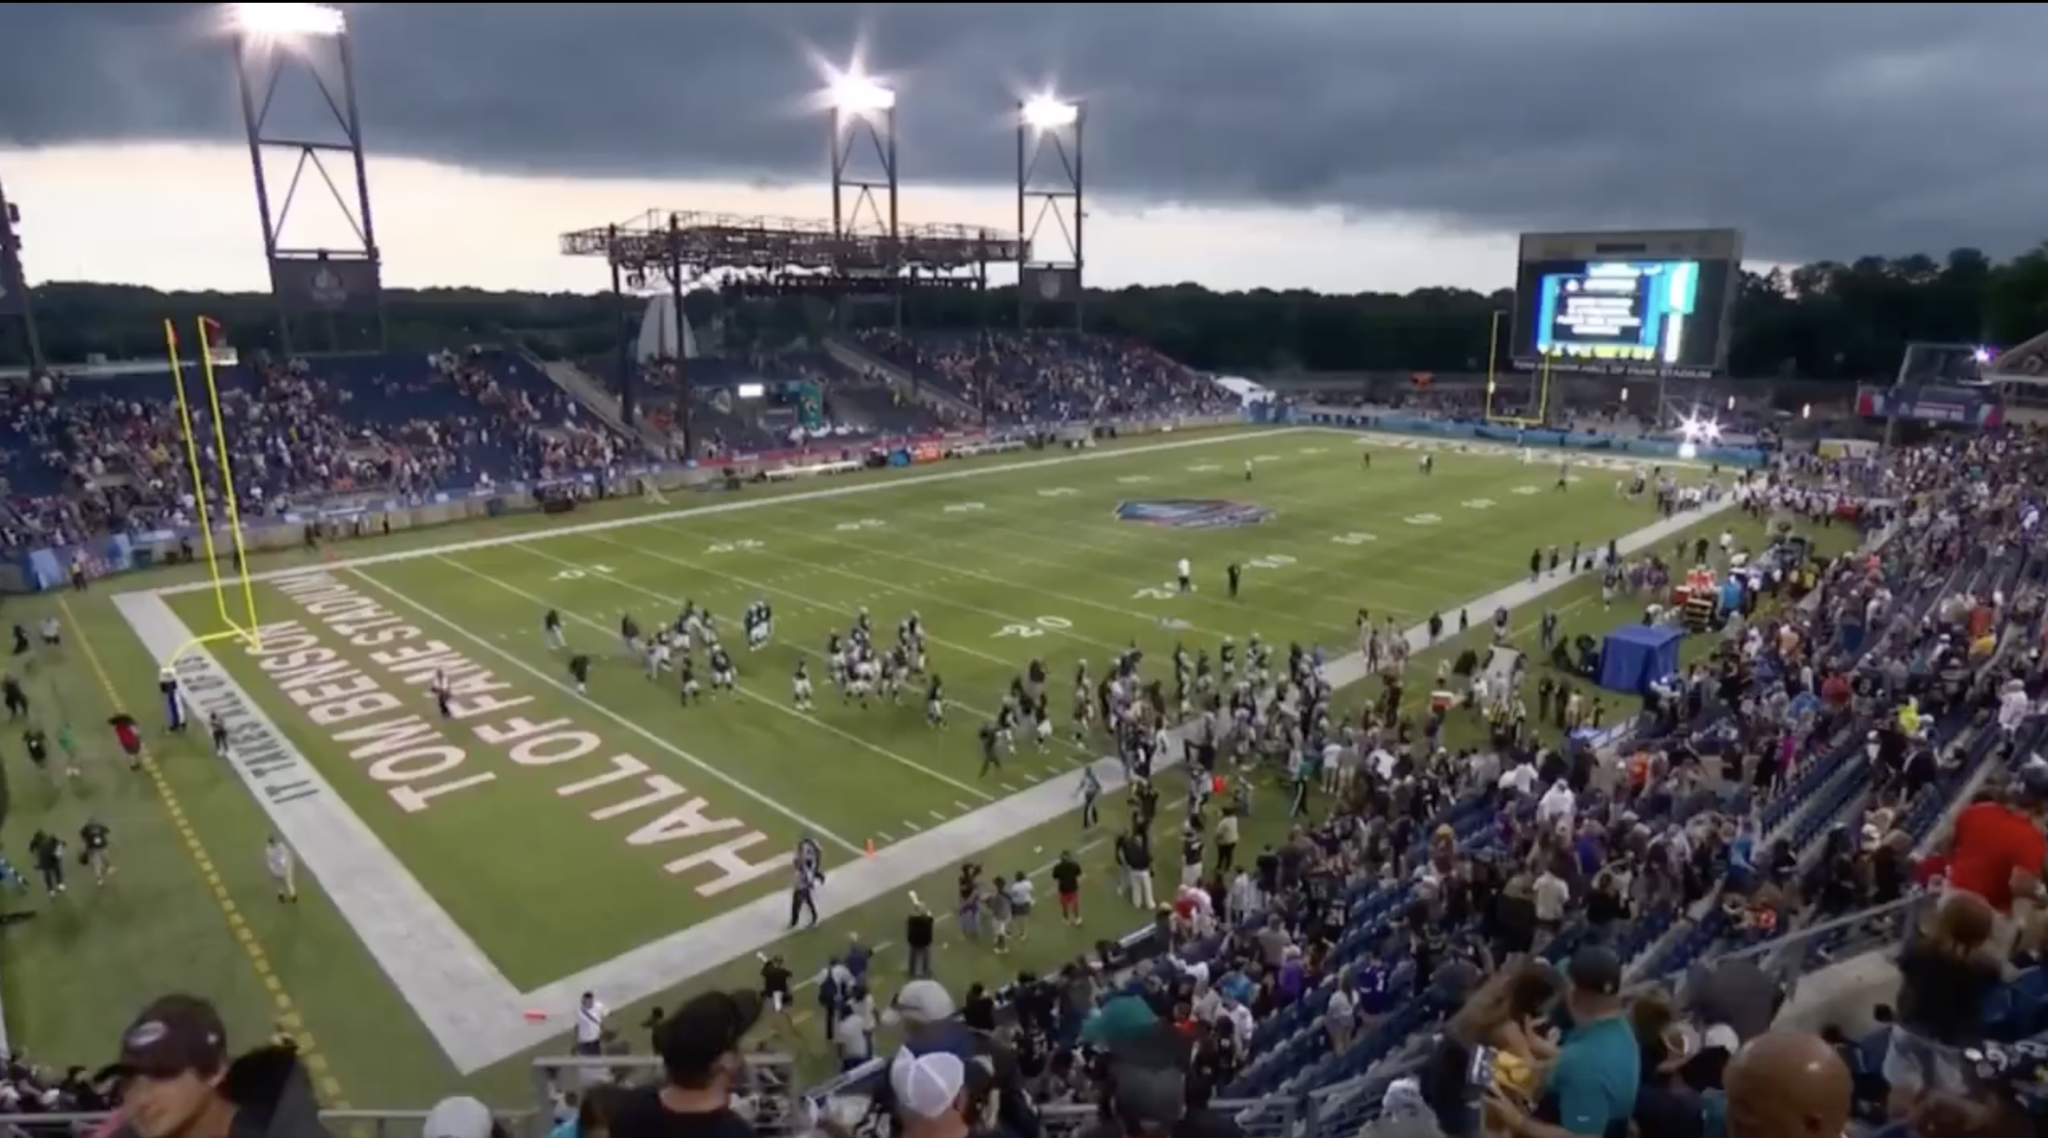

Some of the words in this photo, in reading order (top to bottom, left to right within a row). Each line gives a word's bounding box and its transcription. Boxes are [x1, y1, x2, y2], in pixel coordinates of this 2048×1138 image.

[268, 570, 422, 646] STADIUM
[990, 615, 1073, 638] 20
[237, 619, 404, 726] BENSON
[369, 640, 535, 718] FAME
[331, 714, 497, 812] TOM
[471, 717, 602, 766] OF
[265, 779, 320, 804] IT
[556, 752, 797, 897] HALL
